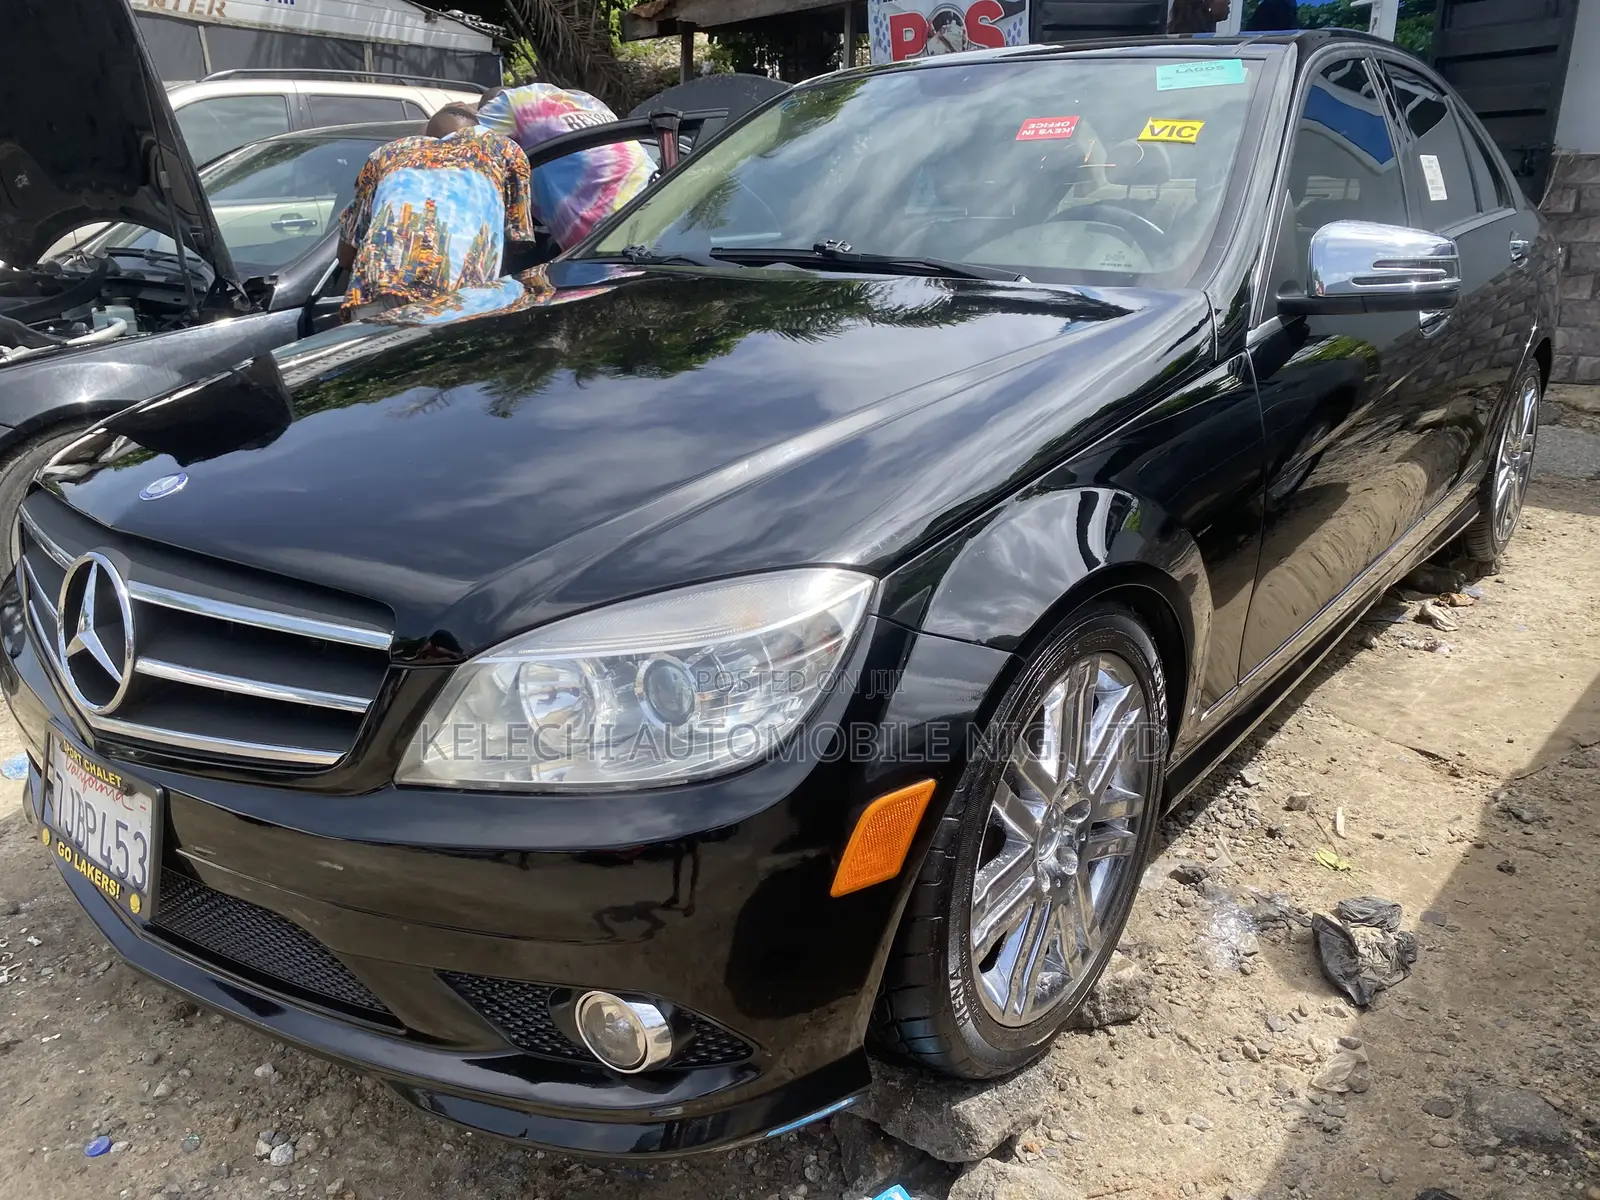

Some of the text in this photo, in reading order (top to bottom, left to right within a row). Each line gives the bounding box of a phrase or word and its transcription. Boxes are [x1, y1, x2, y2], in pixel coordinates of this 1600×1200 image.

[1027, 121, 1071, 129] OFFICE
[1039, 127, 1071, 135] KEYS
[1149, 125, 1197, 138] VIC
[84, 759, 122, 788] CHALET
[56, 771, 148, 892] 7JBP453
[57, 841, 121, 899] GO LAKERS!
